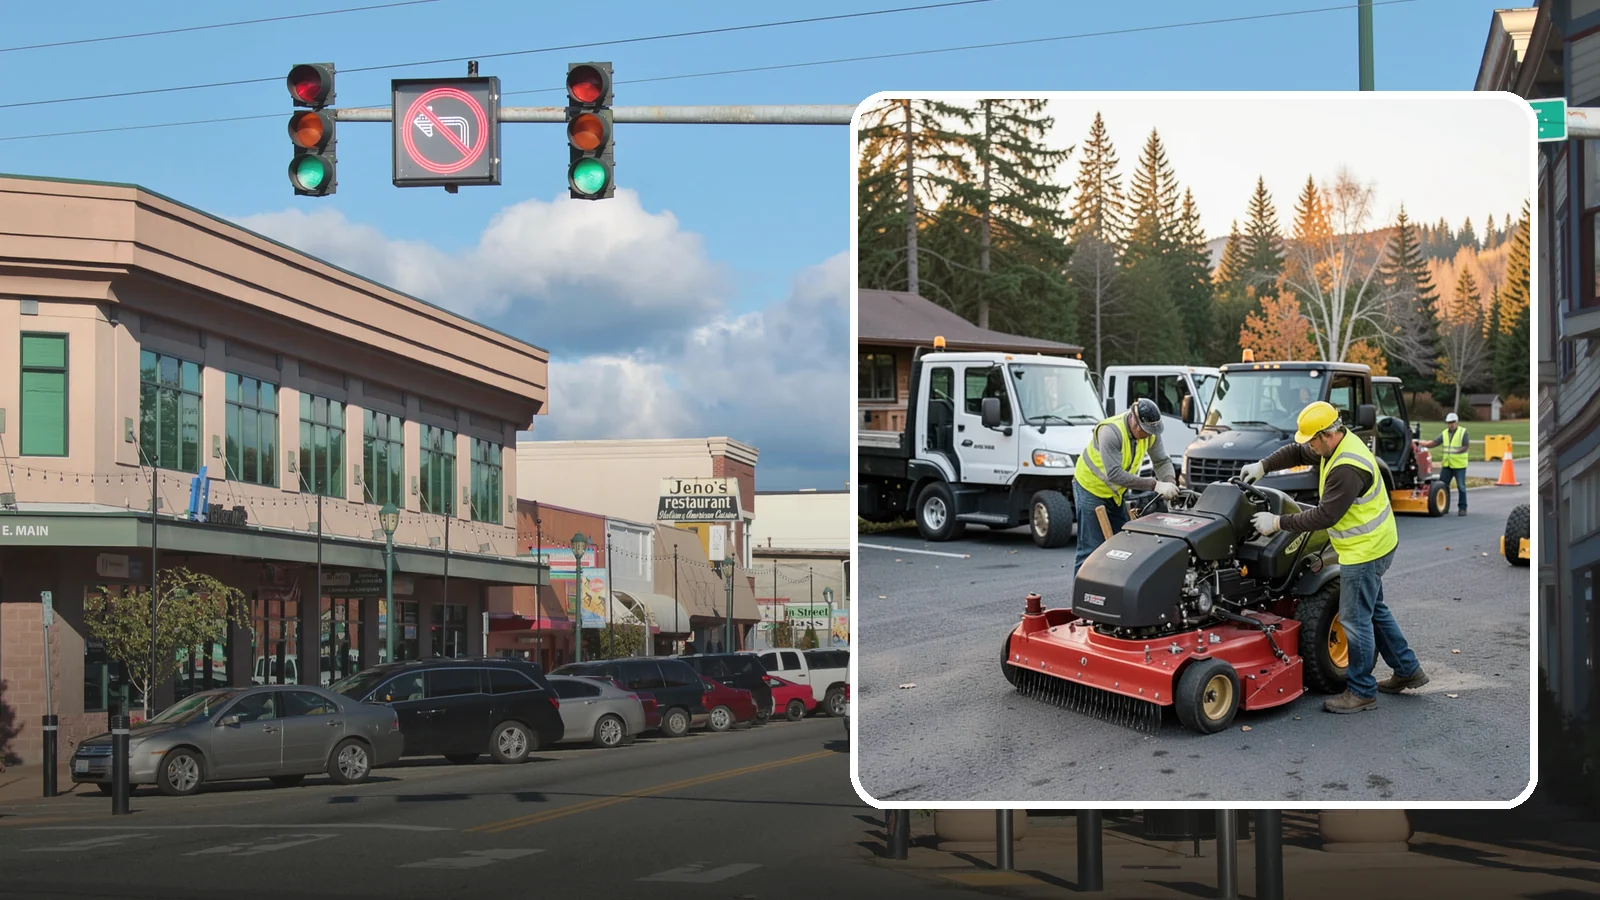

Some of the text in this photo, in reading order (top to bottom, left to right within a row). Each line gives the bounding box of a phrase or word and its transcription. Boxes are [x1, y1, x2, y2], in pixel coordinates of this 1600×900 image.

[670, 480, 728, 495] Jeno's
[665, 497, 731, 509] restaurant
[658, 510, 681, 519] Italian
[686, 509, 714, 519] American
[715, 509, 737, 519] Cuisine
[2, 525, 49, 536] E. MAIN
[798, 607, 828, 616] Street
